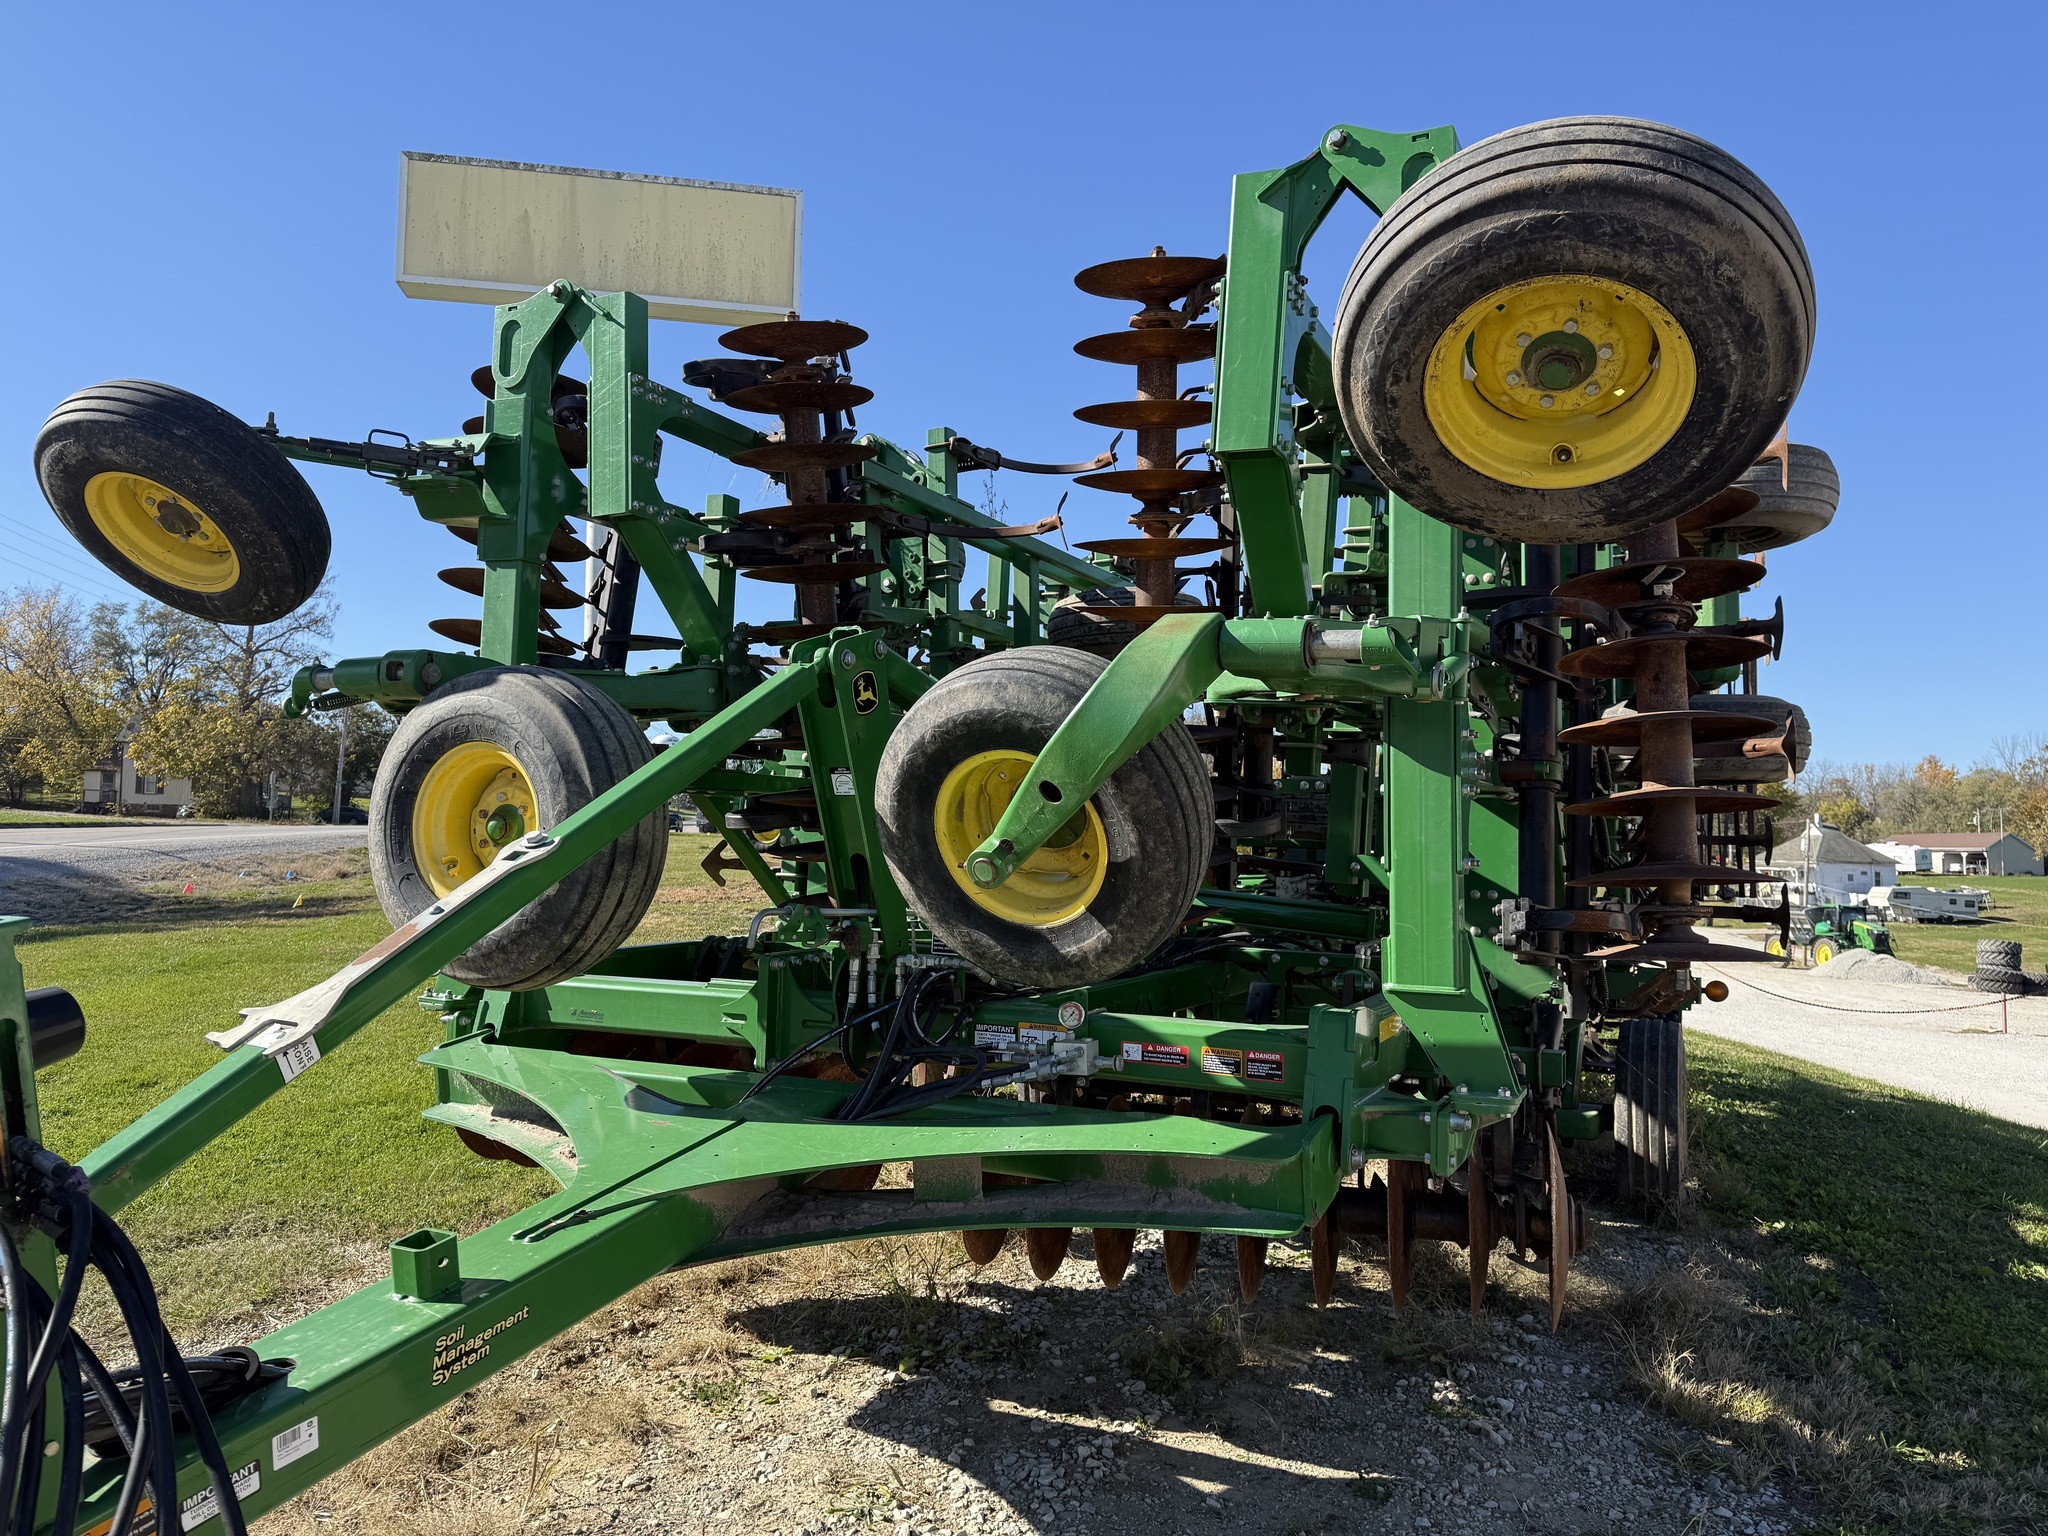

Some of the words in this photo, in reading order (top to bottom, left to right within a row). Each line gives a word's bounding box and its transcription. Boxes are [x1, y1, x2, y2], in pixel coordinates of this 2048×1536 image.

[975, 1023, 1015, 1034] IMPORTANT
[1032, 1023, 1058, 1031] WARNING
[292, 1045, 307, 1070] RONT
[301, 1041, 315, 1063] AISE
[1156, 1045, 1181, 1053] DANGER
[1210, 1048, 1240, 1057] WARNING
[1255, 1052, 1280, 1061] DANGER
[432, 1305, 530, 1371] Management
[434, 1324, 465, 1352] Soil
[431, 1344, 490, 1387] System
[182, 1461, 256, 1512] IMPOANT
